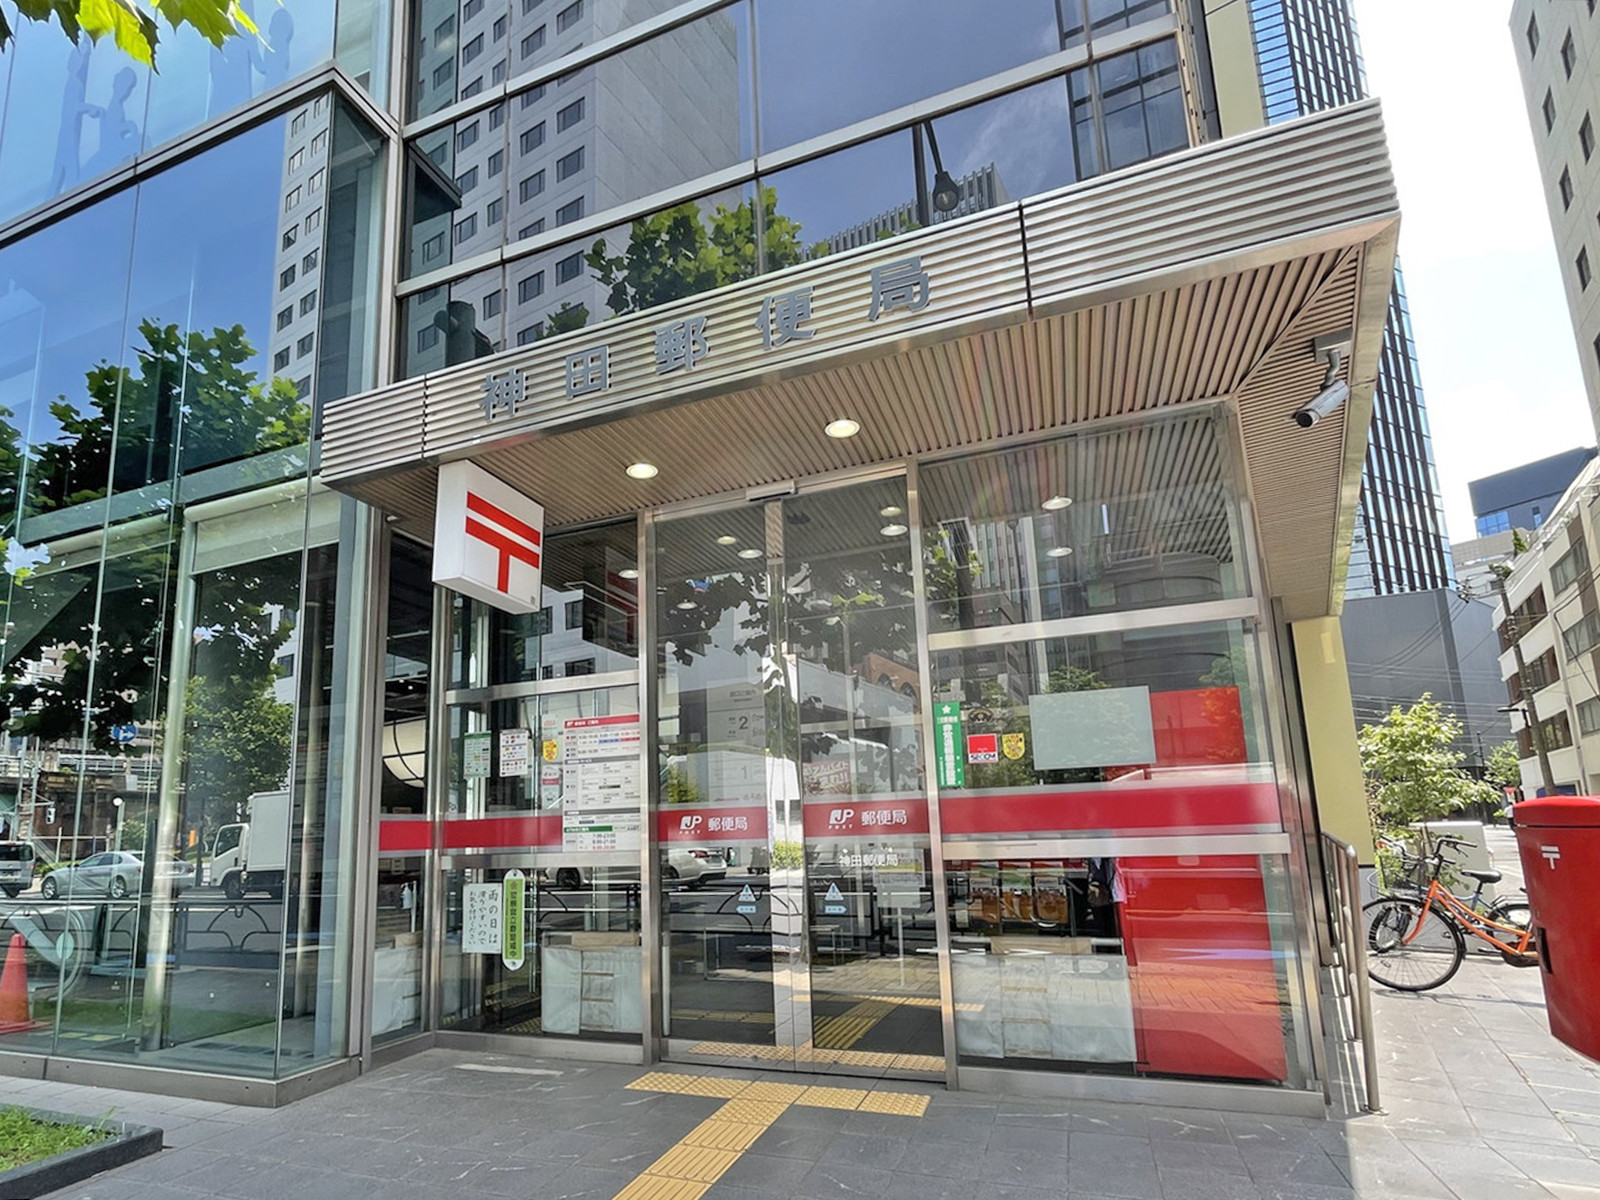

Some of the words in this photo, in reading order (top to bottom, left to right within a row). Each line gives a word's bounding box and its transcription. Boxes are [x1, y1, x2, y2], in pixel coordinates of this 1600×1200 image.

[479, 256, 931, 422] 神田郵便局
[739, 715, 749, 730] 2
[708, 816, 748, 832] 郵便局
[861, 809, 907, 826] 郵便局
[839, 854, 899, 867] 神田郵便局
[488, 889, 499, 944] 雨の日は
